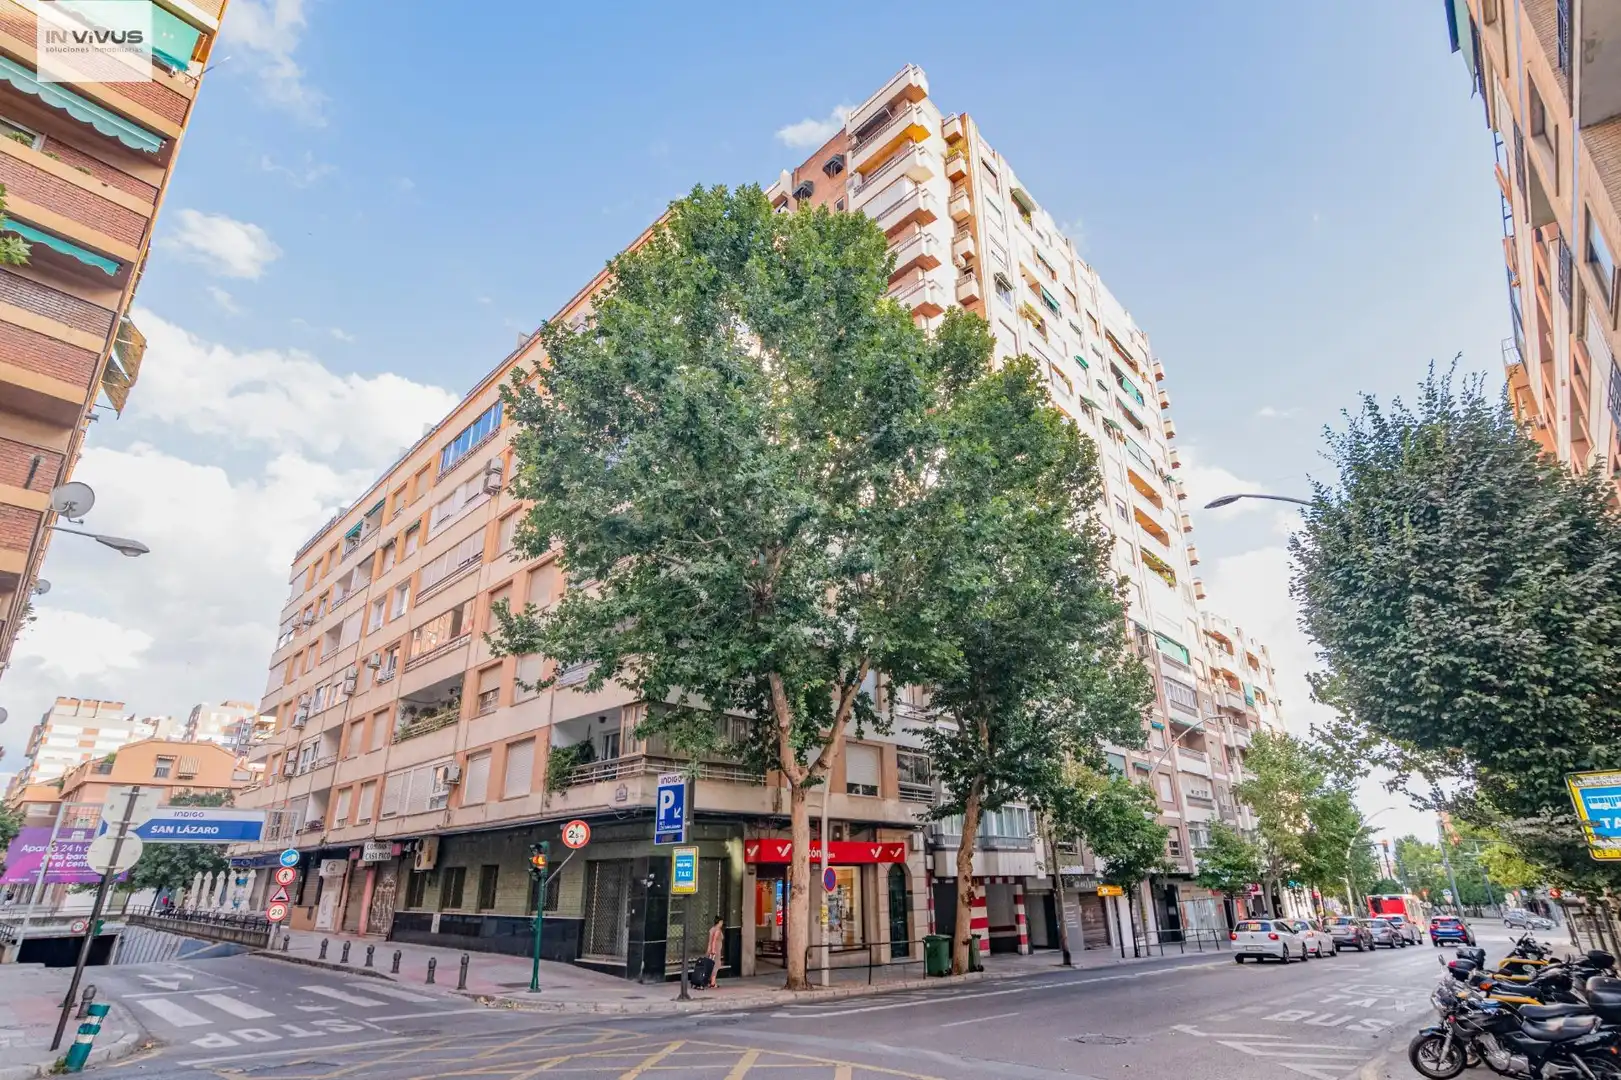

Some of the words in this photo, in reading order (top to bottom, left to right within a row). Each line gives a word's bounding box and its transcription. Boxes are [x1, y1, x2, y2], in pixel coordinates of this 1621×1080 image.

[659, 789, 675, 820] P
[150, 825, 174, 834] SAN
[176, 824, 219, 834] LÁZARO
[61, 844, 73, 852] 24
[271, 908, 283, 916] 20
[1261, 1009, 1394, 1032] BUS
[189, 1019, 364, 1048] STOP
